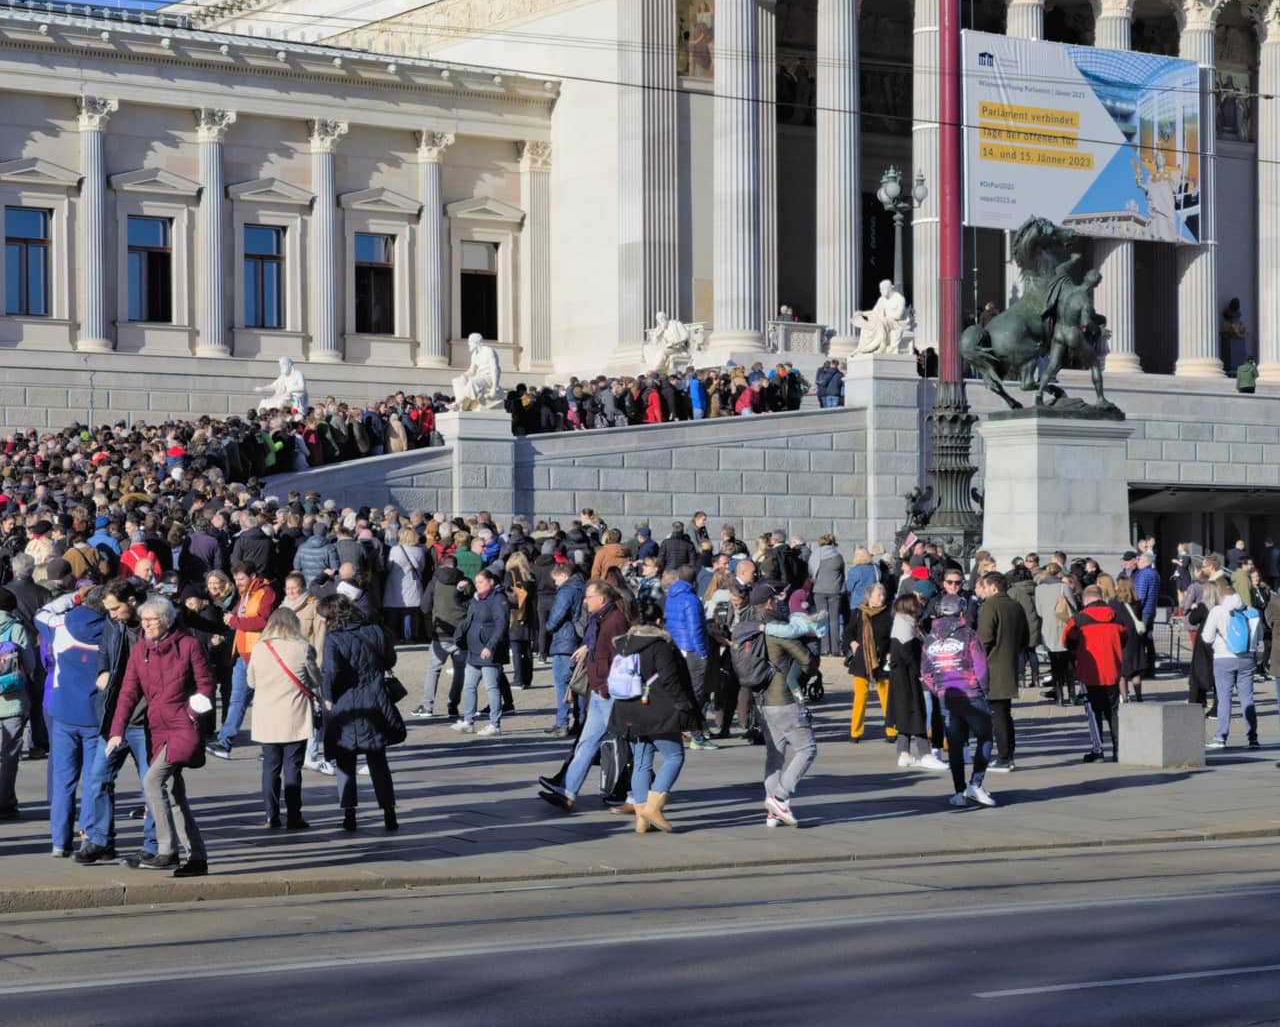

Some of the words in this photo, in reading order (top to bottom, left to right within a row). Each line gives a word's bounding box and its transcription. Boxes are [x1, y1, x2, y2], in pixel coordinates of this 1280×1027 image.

[982, 106, 1028, 121] Parlament
[1000, 150, 1017, 160] und
[1037, 153, 1066, 164] Jänner
[1068, 156, 1091, 167] 2023
